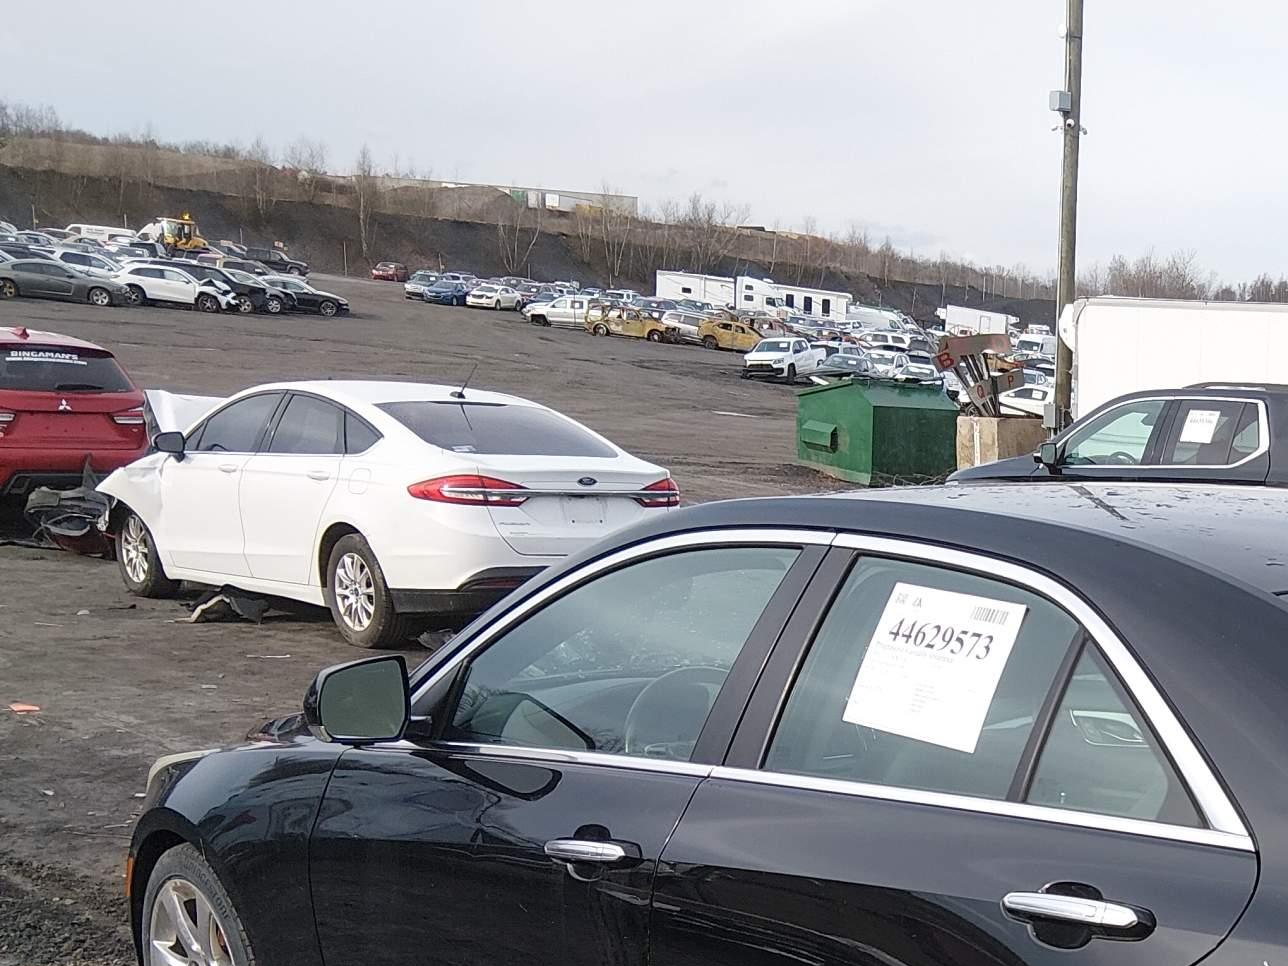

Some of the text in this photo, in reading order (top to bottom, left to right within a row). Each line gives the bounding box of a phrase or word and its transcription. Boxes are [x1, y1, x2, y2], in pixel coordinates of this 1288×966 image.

[10, 350, 79, 361] BINGAMAN'S
[938, 352, 955, 368] B
[887, 617, 995, 660] 44629573
